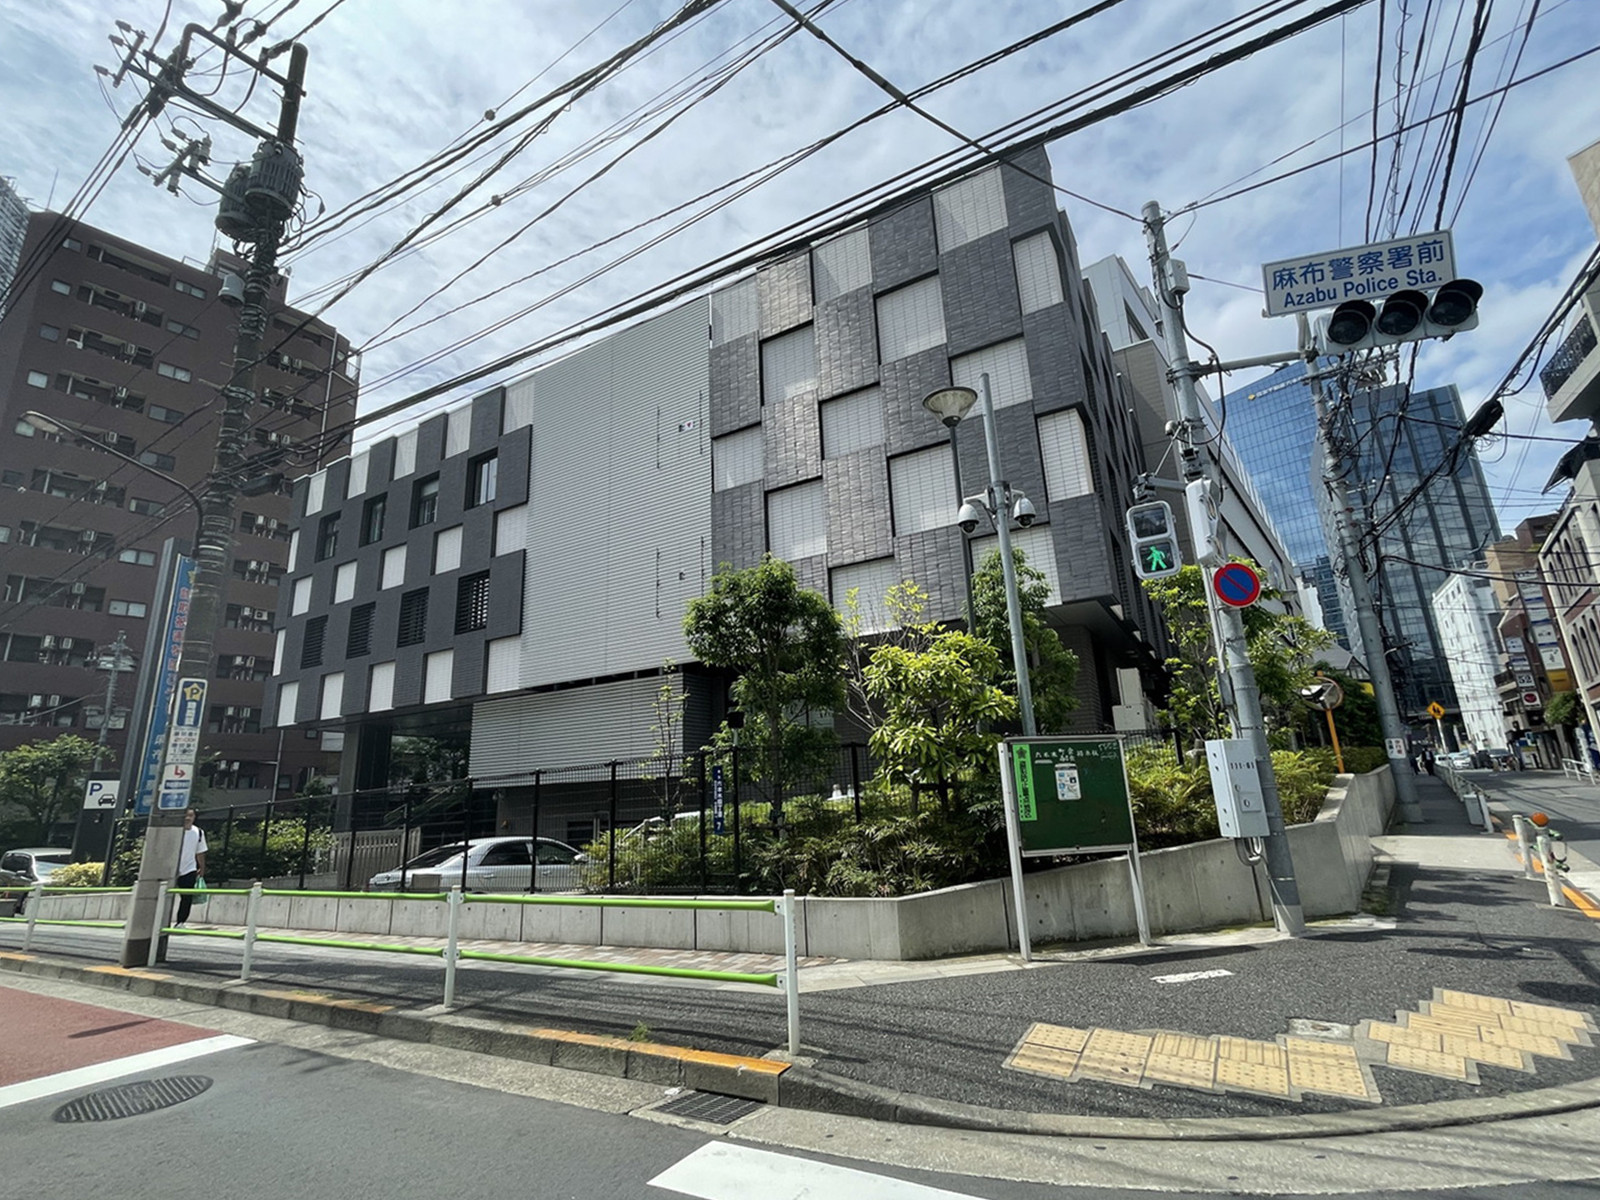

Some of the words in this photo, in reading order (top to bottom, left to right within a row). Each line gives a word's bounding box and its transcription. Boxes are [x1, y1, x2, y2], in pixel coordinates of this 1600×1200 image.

[1272, 239, 1444, 291] 麻布警察署前
[1284, 286, 1337, 308] Azabu
[1344, 276, 1398, 298] Police
[1406, 268, 1442, 286] Sta.
[1517, 674, 1532, 684] 52
[190, 687, 200, 698] P
[89, 782, 103, 796] P
